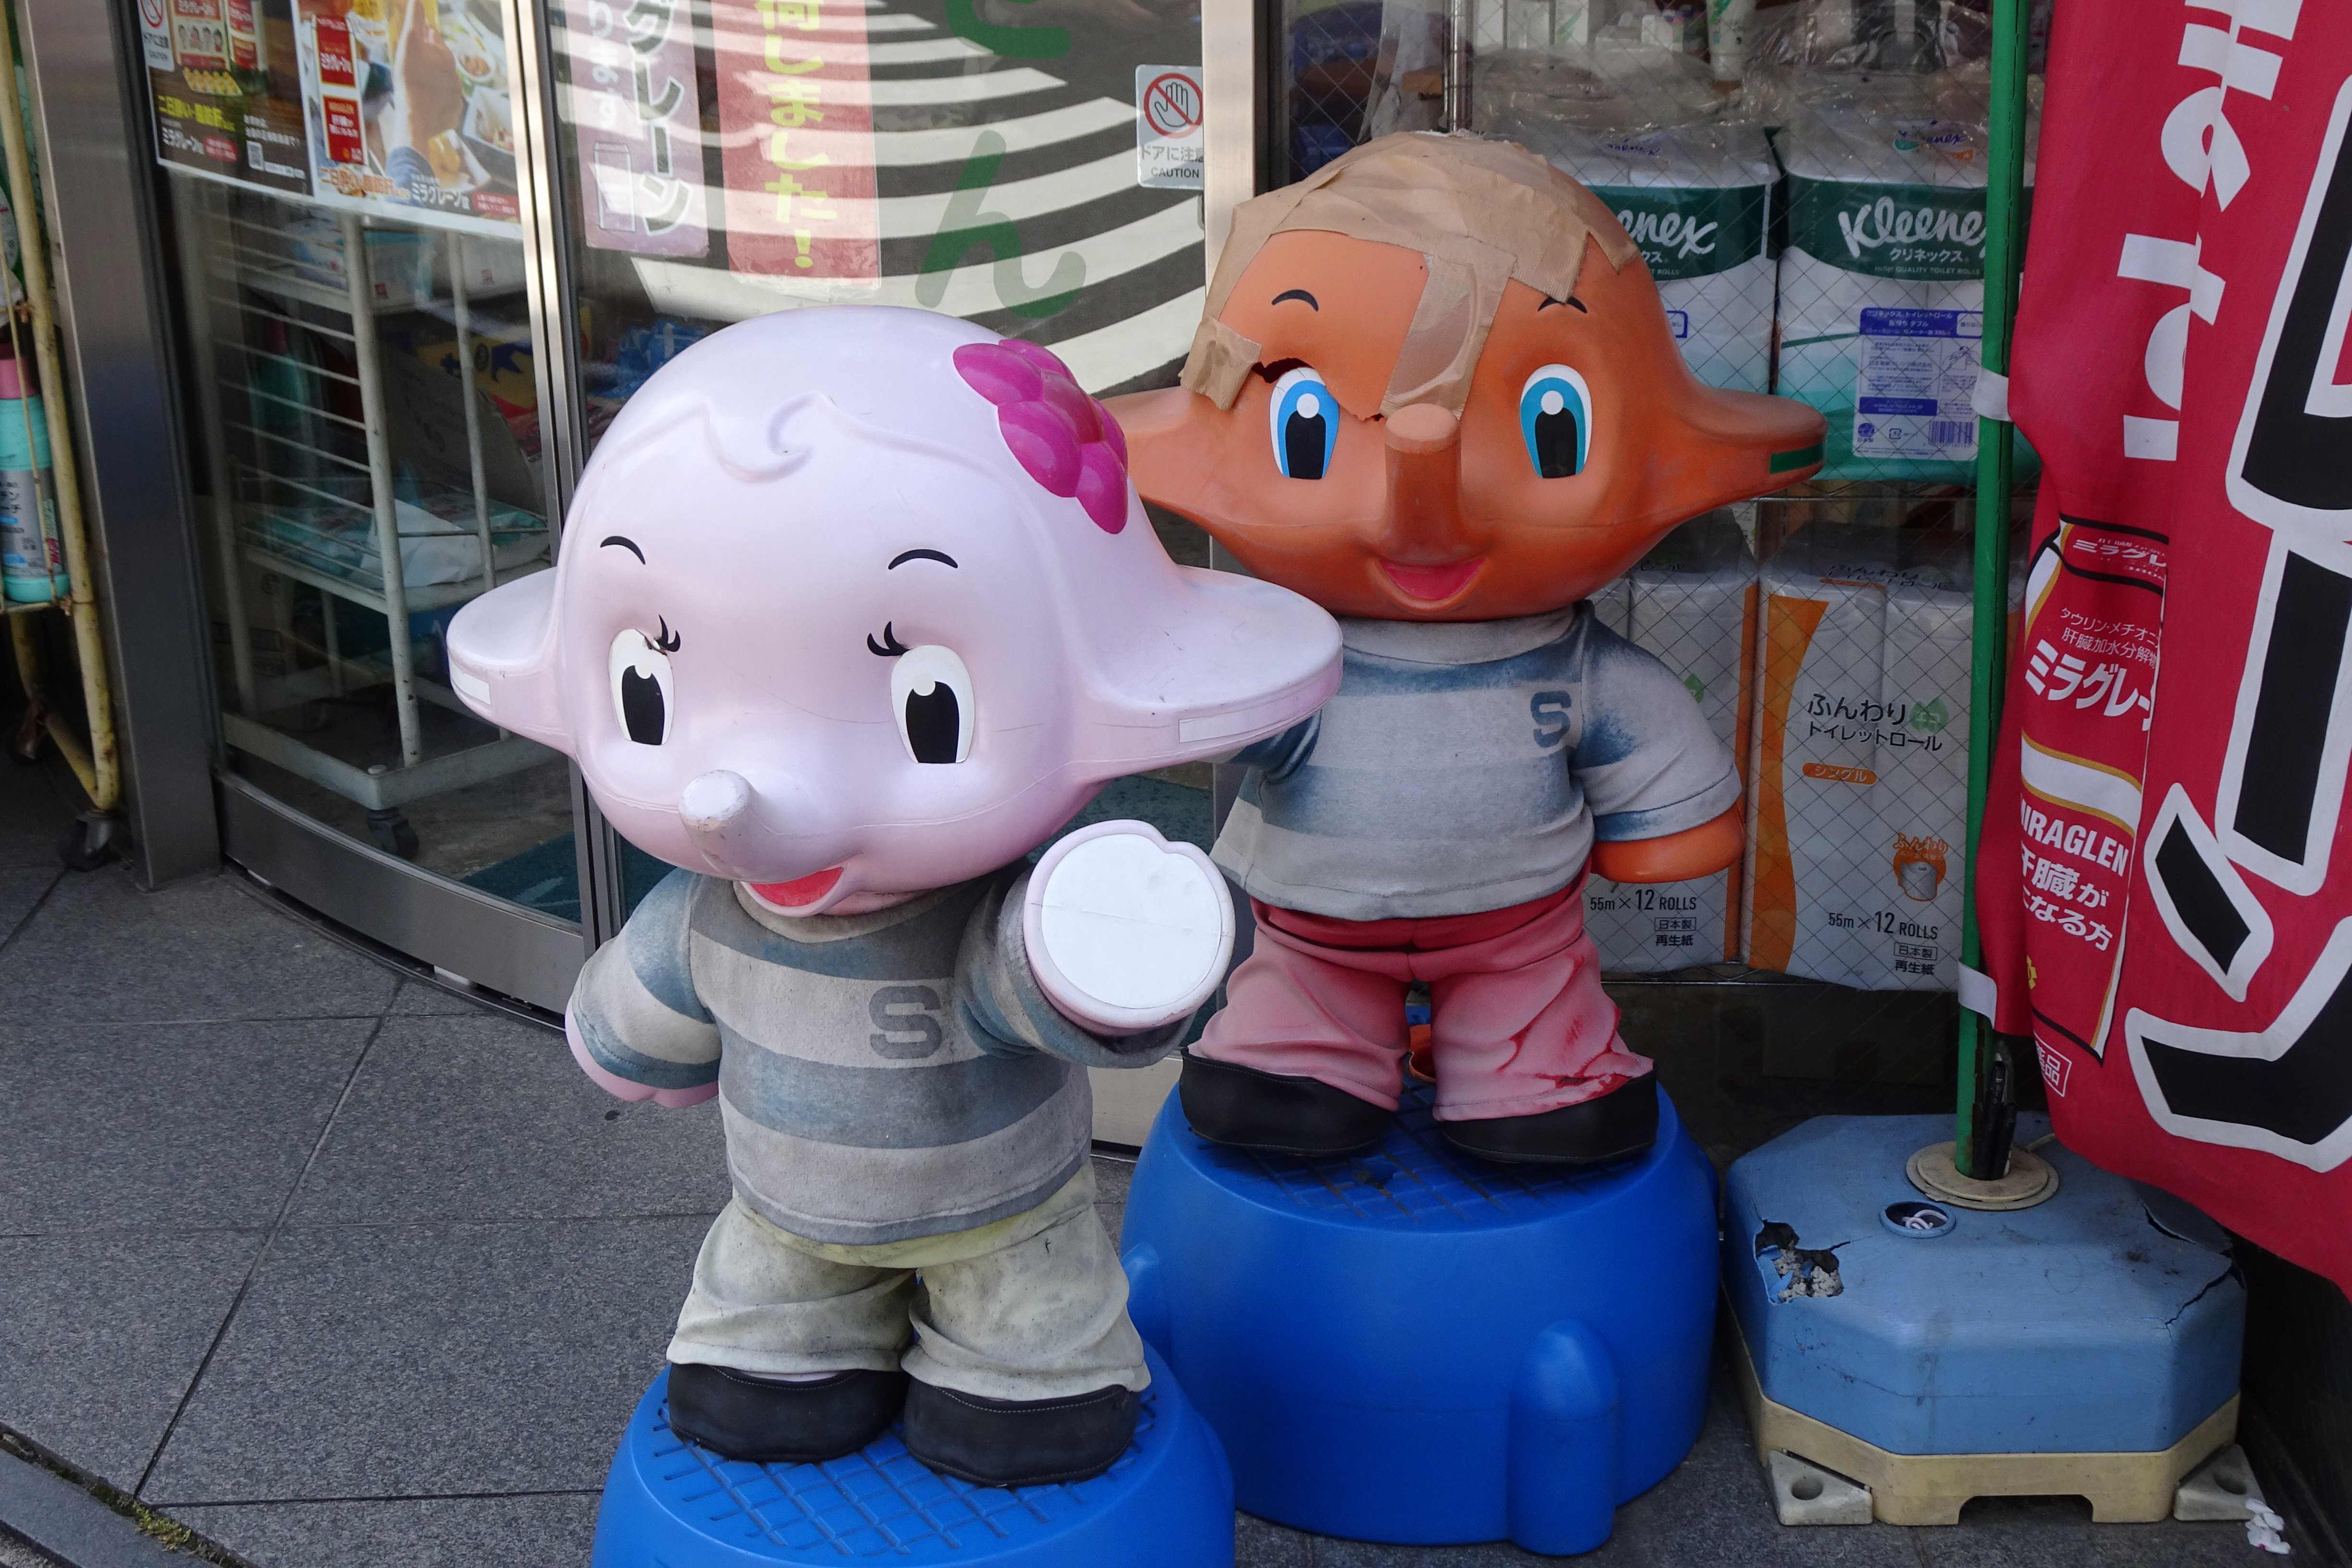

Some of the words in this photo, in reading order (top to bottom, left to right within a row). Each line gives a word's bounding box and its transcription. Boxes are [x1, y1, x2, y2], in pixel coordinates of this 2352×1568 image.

[1141, 145, 1204, 162] ドアに注意
[1151, 167, 1200, 178] CAUTION
[1889, 247, 1963, 263] クリネックス
[2060, 608, 2159, 649] タウリン・メチオニ
[1808, 693, 1906, 725] ふんわり
[1530, 690, 1572, 748] S
[1810, 721, 1943, 751] トイレットロール
[1814, 765, 1867, 783] シングル
[2021, 798, 2130, 877] IRAGLEN
[1590, 896, 1615, 910] 55m
[1635, 889, 1655, 910] 12
[1659, 896, 1697, 910] ROLLS
[1659, 919, 1692, 930] 日本製
[1828, 913, 1854, 929] 55m
[1874, 911, 1895, 934] 12
[1899, 922, 1938, 940] ROLLS
[1655, 934, 1694, 947] 再生紙
[1899, 944, 1933, 958] 日本製
[1895, 959, 1935, 975] 再生紙
[868, 985, 942, 1059] S
